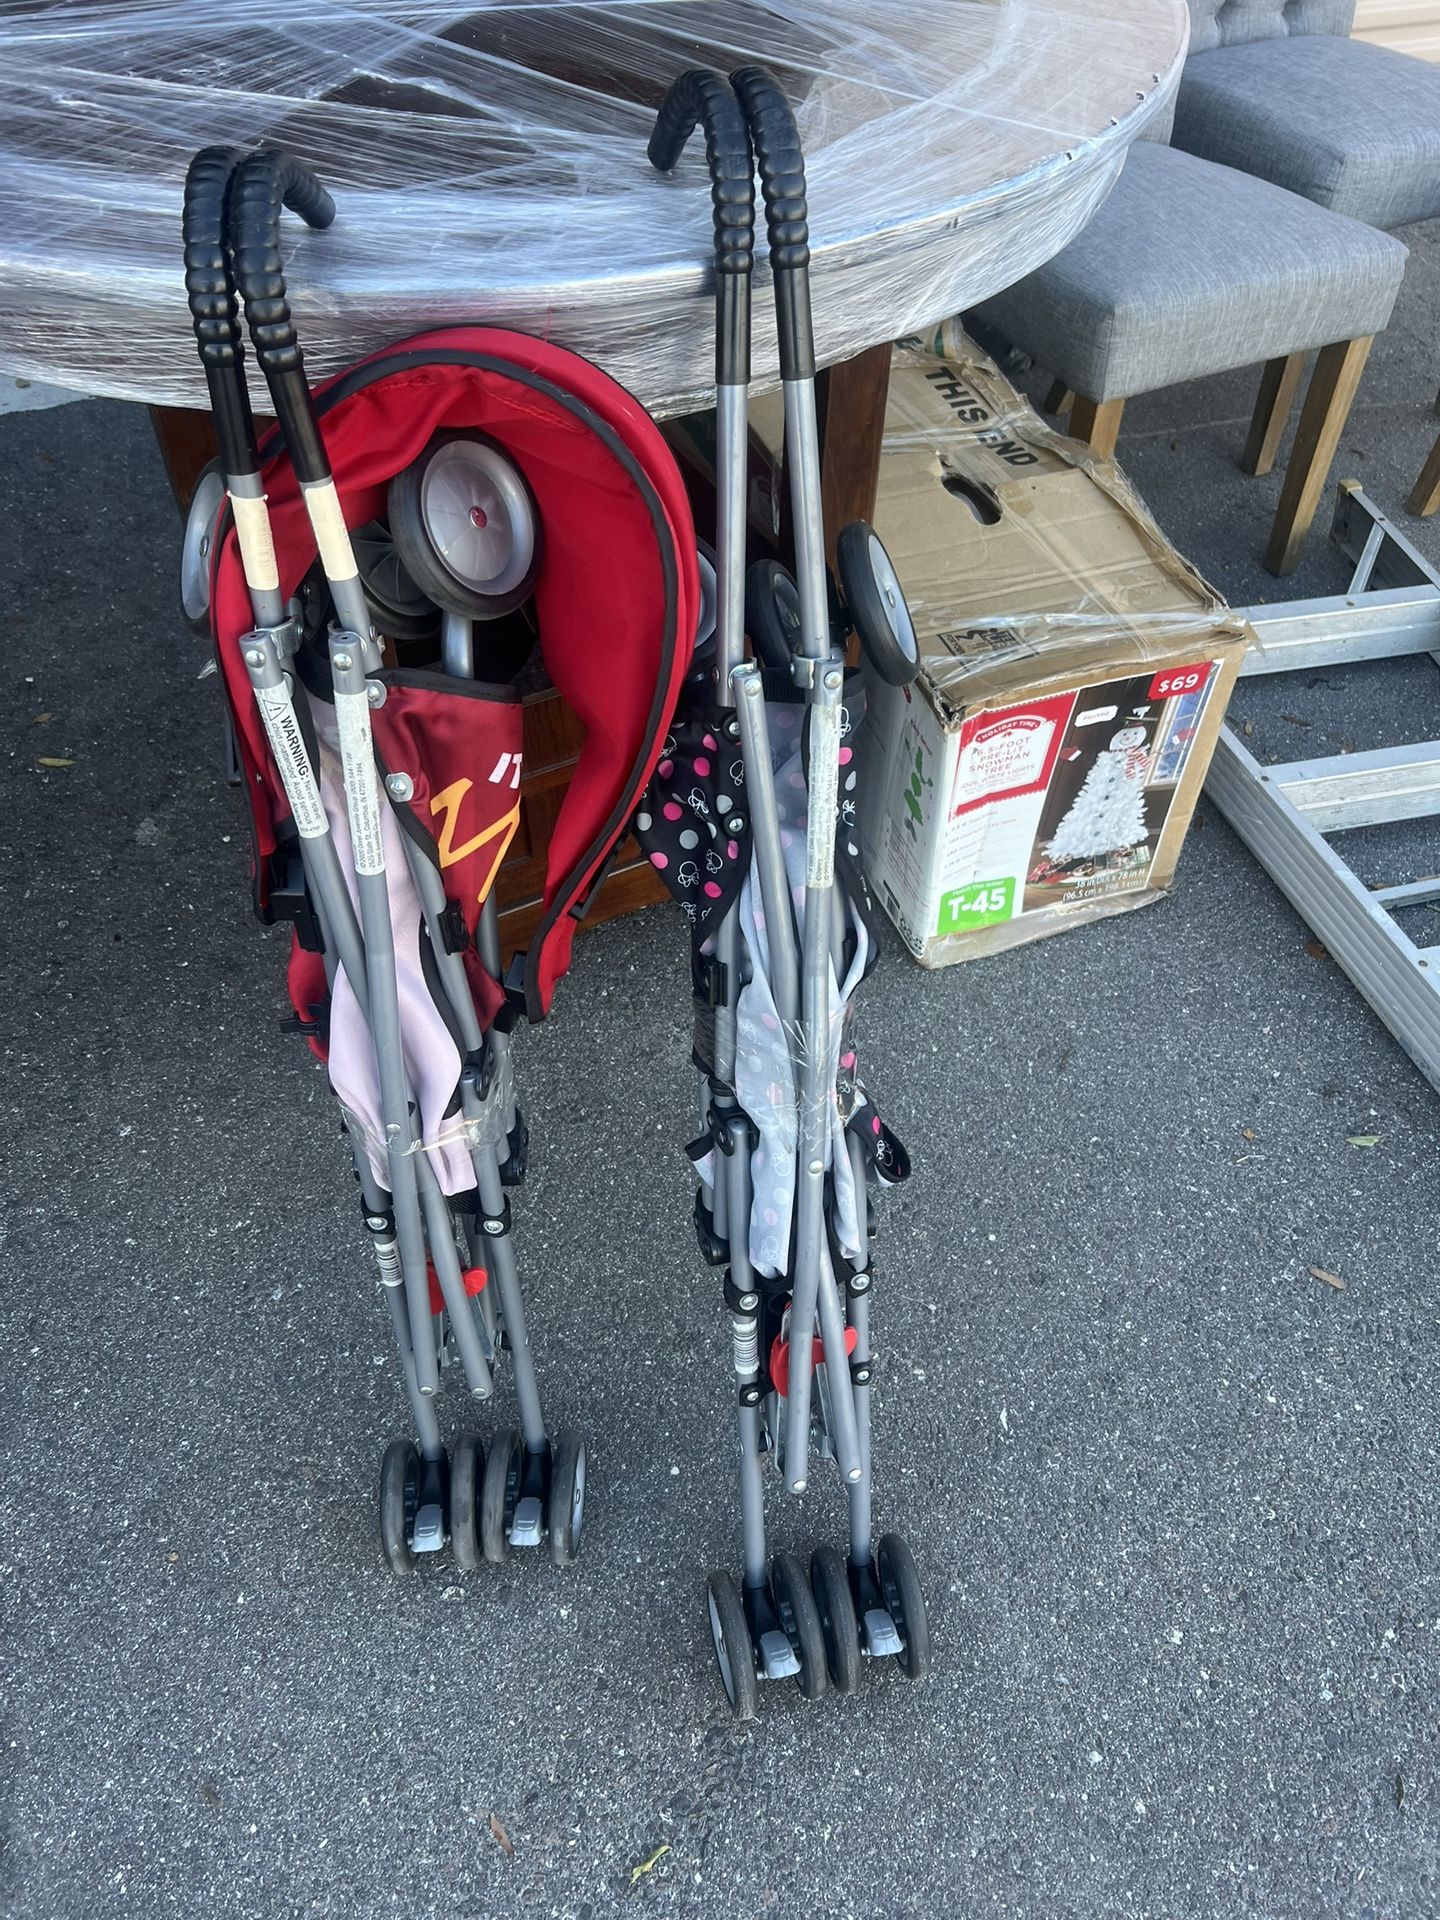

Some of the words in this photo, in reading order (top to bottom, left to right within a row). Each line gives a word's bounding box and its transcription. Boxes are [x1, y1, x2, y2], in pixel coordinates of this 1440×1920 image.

[924, 366, 989, 424] THIS
[973, 427, 1039, 466] END
[1158, 673, 1199, 693] $69
[981, 720, 1017, 740] HOLIDAY
[1019, 720, 1035, 728] TIME
[271, 721, 284, 740] child
[291, 780, 305, 800] Avoid
[969, 752, 1030, 773] SNOWMAN
[980, 746, 1023, 763] PRE-LIT
[280, 715, 310, 780] WARNING:
[303, 779, 316, 800] Never
[310, 800, 322, 820] leave
[985, 763, 1012, 775] TREE
[1075, 880, 1085, 889] 38
[1087, 878, 1095, 886] in
[1118, 870, 1128, 880] 78
[1129, 870, 1138, 878] in
[948, 887, 1006, 921] T-45
[1063, 889, 1083, 902] (96.5
